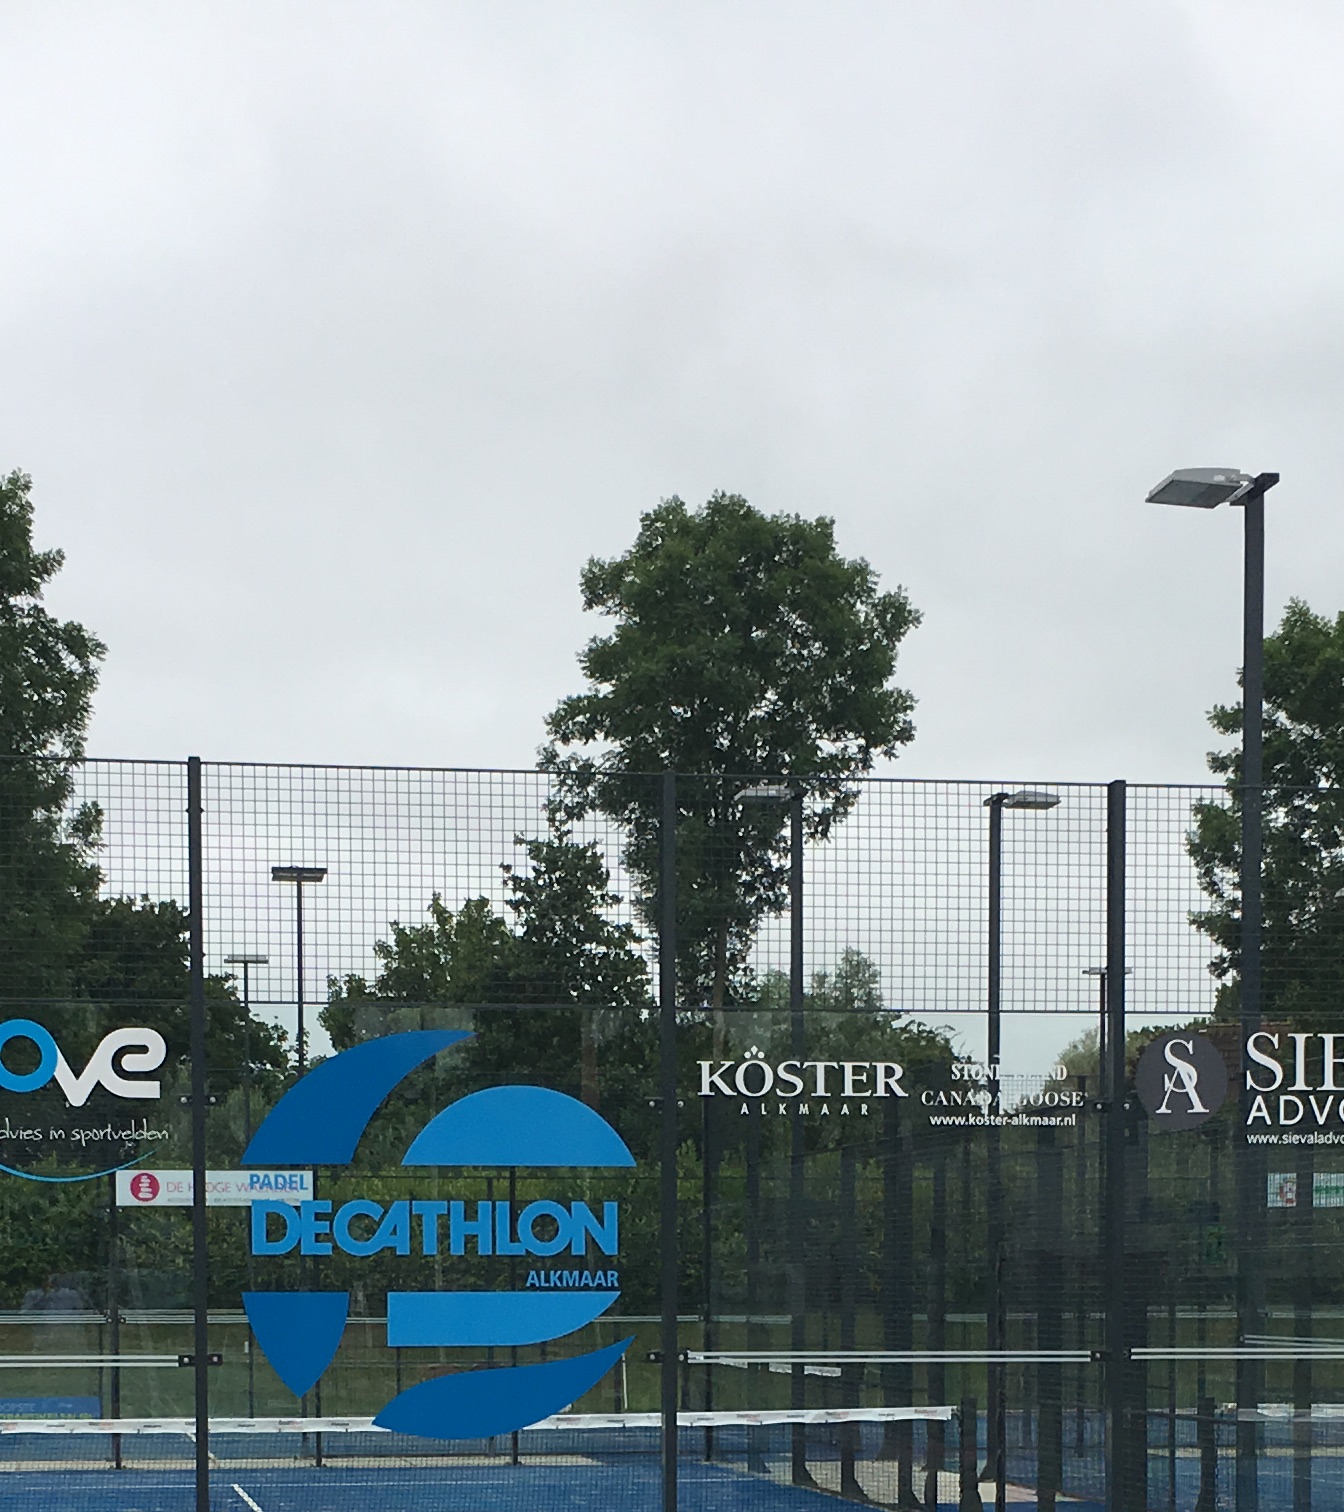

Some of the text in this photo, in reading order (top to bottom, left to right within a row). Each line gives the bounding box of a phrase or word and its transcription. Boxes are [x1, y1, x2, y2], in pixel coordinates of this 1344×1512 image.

[697, 1045, 908, 1098] KÖSTER
[741, 1103, 869, 1116] ALKMAAR
[930, 1113, 1076, 1126] www.koster-alkmaar.nl
[49, 1126, 66, 1140] in
[71, 1118, 169, 1147] sportvelden
[249, 1173, 309, 1190] PADEL
[251, 1200, 619, 1256] DECATHLON
[526, 1270, 619, 1287] ALKMAAR
